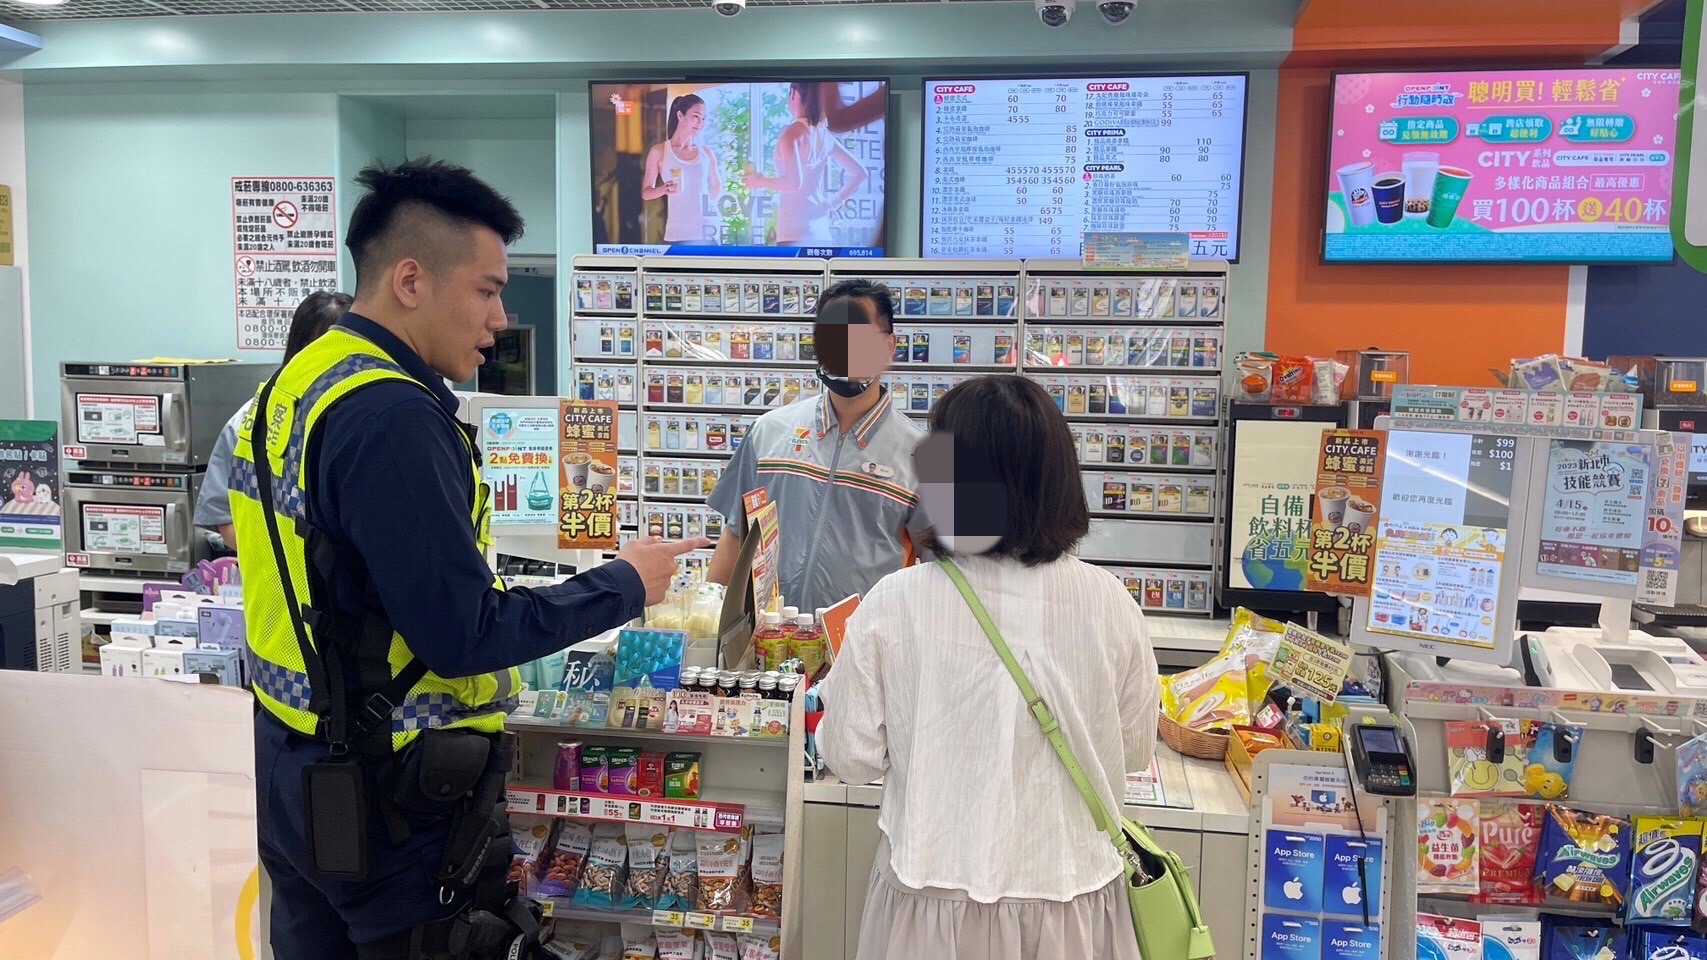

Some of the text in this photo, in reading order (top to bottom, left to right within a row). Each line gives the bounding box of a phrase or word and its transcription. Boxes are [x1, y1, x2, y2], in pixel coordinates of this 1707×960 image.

[1552, 79, 1621, 102] 輕鬆省
[1407, 120, 1444, 129] 指定商品
[1506, 119, 1544, 128] 跨店領取
[1586, 118, 1624, 127] 無限轉贈
[1478, 151, 1531, 167] CITY
[1534, 150, 1551, 158] 系列
[1532, 159, 1550, 168] 飲品
[1495, 176, 1589, 190] 多樣化商品組合
[1595, 177, 1639, 188] 最高優惠
[702, 196, 772, 217] LOVE
[1191, 240, 1228, 257] 五元
[1279, 367, 1303, 383] Ovaltine
[588, 415, 611, 423] CAFE
[567, 425, 595, 438] 蜂蜜
[1325, 445, 1377, 455] CITY CAFE
[1497, 439, 1514, 448] $99
[1489, 450, 1513, 459] $100
[1325, 457, 1356, 472] 蜂蜜
[1500, 461, 1511, 471] $1
[1579, 454, 1610, 470] 新北市
[1564, 473, 1621, 490] 技能競賽
[562, 490, 615, 511] 第2杯
[1261, 494, 1304, 516] 自備
[1556, 499, 1581, 509] 4/15
[561, 512, 611, 537] 半價
[1315, 526, 1373, 552] 第2杯
[1312, 551, 1368, 583] 半價
[1482, 822, 1533, 844] Puré
[1274, 848, 1315, 858] App Store
[1432, 843, 1458, 852] 益生菌
[1335, 854, 1351, 862] App
[1559, 846, 1617, 864] Airwaves
[1640, 856, 1692, 913] Airwaves
[1272, 932, 1311, 943] App Store
[1331, 938, 1371, 949] App Store
